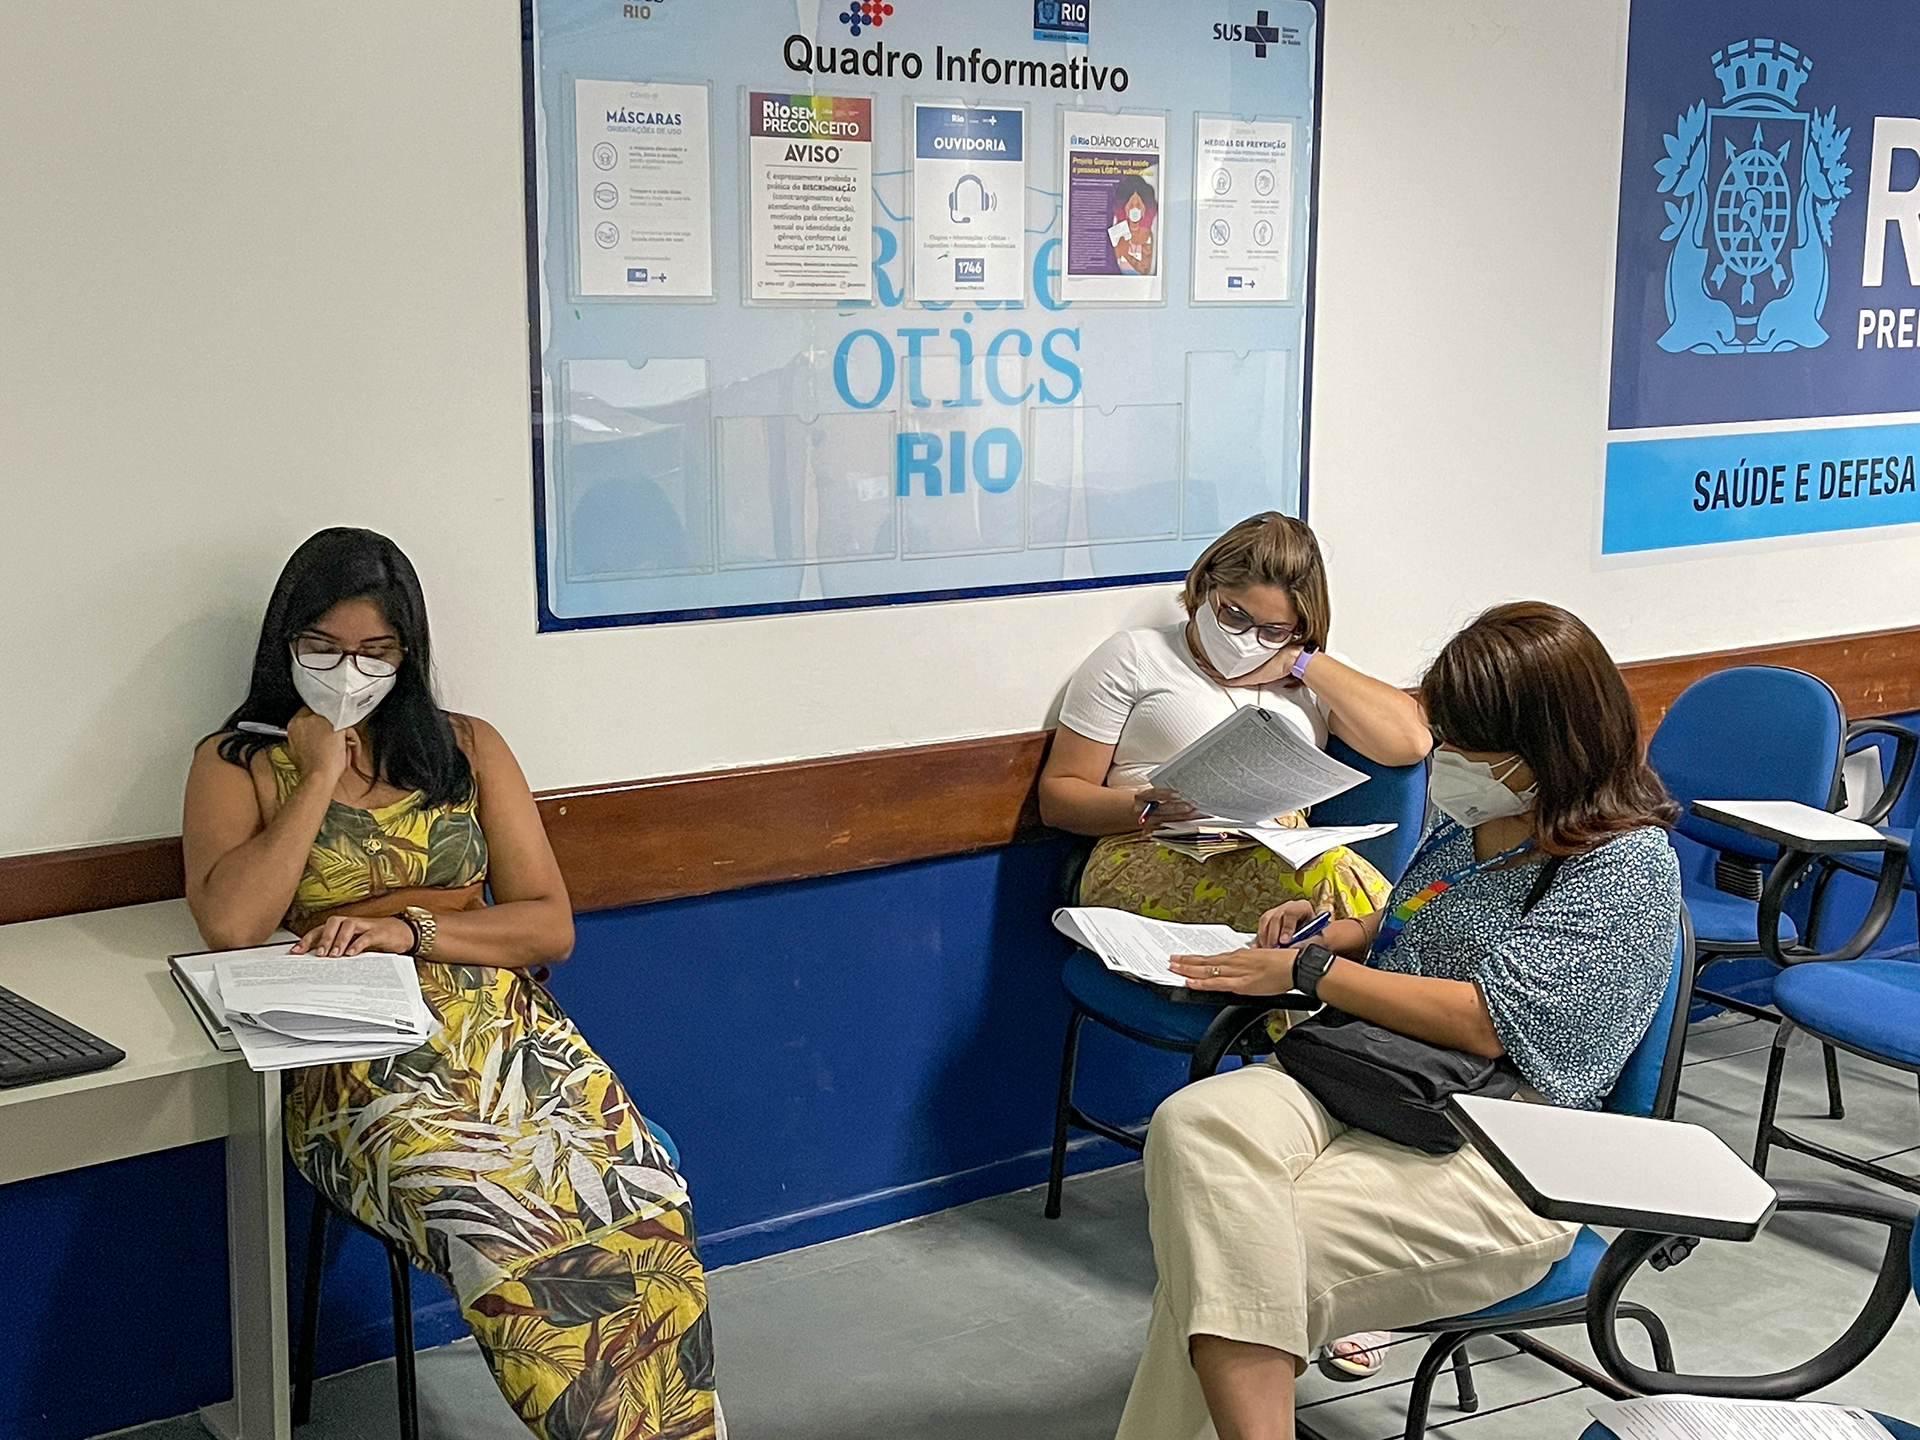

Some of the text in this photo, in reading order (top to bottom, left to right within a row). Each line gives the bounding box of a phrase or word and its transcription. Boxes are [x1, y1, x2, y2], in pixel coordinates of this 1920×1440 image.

[623, 4, 651, 19] RIO
[1061, 3, 1086, 21] RIO
[1213, 23, 1242, 41] SUS
[783, 34, 1129, 92] Quadro Informativo
[606, 107, 682, 126] MÁSCARAS
[951, 114, 965, 123] Rio
[606, 125, 655, 135] ORIENTAÇÕES
[763, 118, 860, 136] PRECONCEITO
[933, 137, 1006, 151] OUVIDORIA
[1078, 134, 1159, 148] Rio DIÁRIO OFICIAL
[1204, 139, 1234, 147] MEDIDAS
[1246, 140, 1287, 150] PREVENÇÃO
[784, 144, 840, 163] AVISO
[772, 173, 822, 181] expressamente
[767, 183, 790, 191] prática
[802, 183, 857, 193] DISCRIMINAÇÃO
[835, 194, 851, 203] e/ou
[767, 203, 810, 211] atendimento
[770, 213, 853, 223] motivado pela orientação
[805, 223, 841, 231] identidade
[842, 224, 851, 232] de
[773, 243, 805, 252] Municipal
[958, 261, 982, 274] 1746
[1857, 308, 1920, 350] PRE
[896, 427, 1022, 497] RIO
[1693, 455, 1916, 512] SAÚDE E DEFESA
